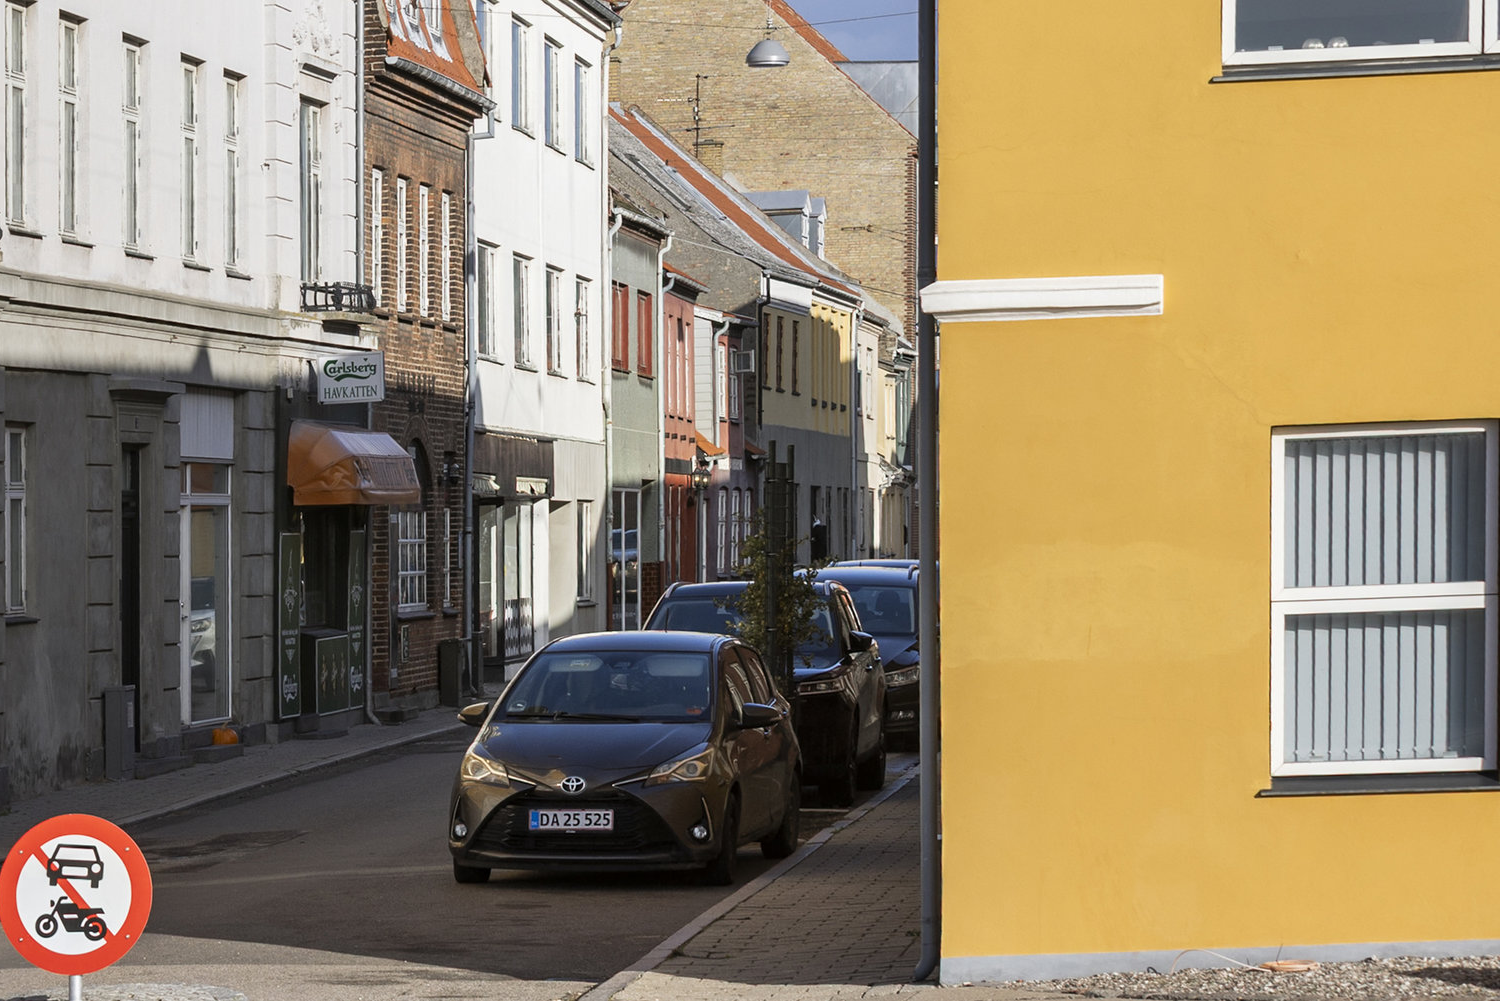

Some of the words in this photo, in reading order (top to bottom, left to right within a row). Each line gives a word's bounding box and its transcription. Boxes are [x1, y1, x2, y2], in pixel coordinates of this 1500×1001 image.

[324, 359, 377, 380] Carlsberg
[324, 385, 378, 399] HAVKATTEN
[540, 813, 560, 826] DA
[563, 813, 581, 826] 25
[584, 813, 610, 826] 525
